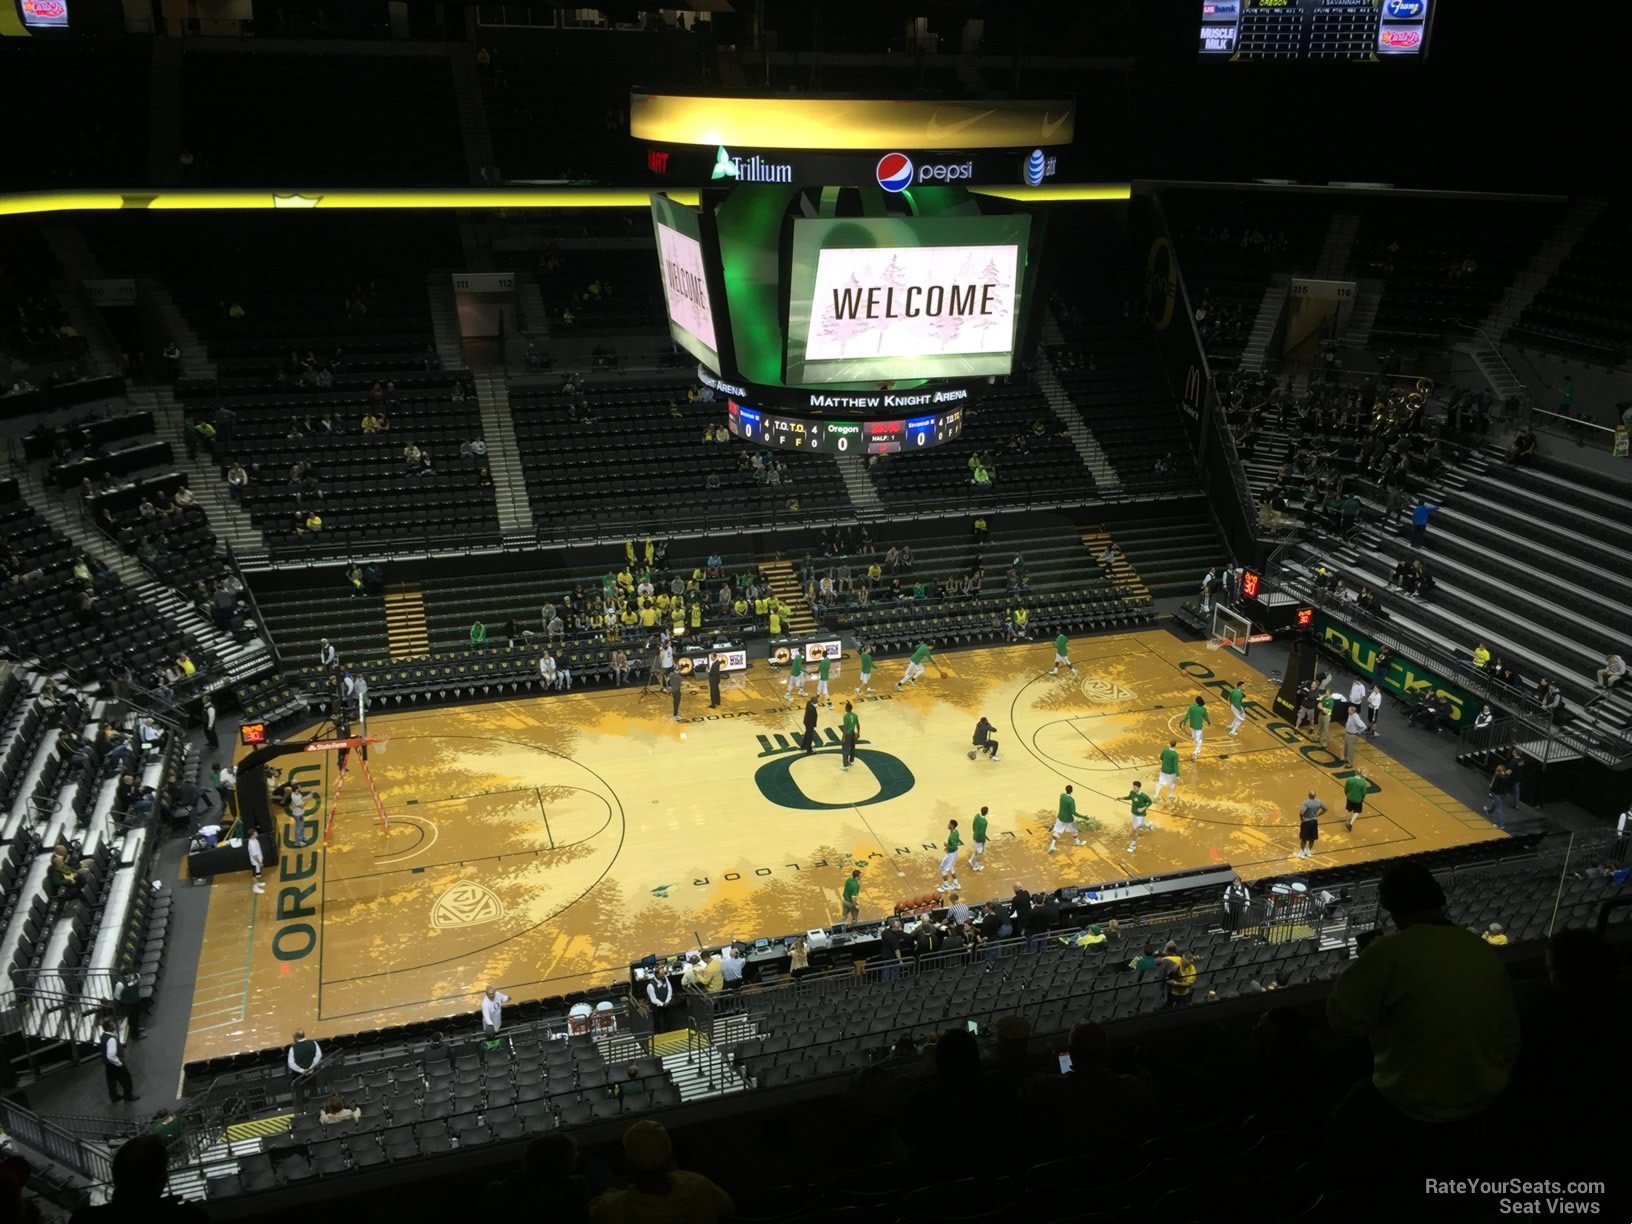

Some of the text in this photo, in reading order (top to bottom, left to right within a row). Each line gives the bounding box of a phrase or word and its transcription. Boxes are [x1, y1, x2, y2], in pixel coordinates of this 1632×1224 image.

[1200, 28, 1234, 39] MUSCLE
[1205, 40, 1227, 49] MILK
[732, 156, 792, 183] Trillium
[918, 161, 972, 183] pepsi
[665, 259, 706, 310] WELCOME
[833, 284, 996, 320] WELCOME
[717, 380, 747, 398] ARENA
[810, 389, 967, 408] MATTHEW KNIGHT ARENA
[764, 419, 769, 428] 4
[811, 425, 817, 434] 4
[827, 424, 859, 434] Oregon
[745, 423, 752, 438] 0
[764, 432, 770, 442] 0
[780, 435, 786, 444] F
[917, 432, 925, 446] 0
[811, 439, 818, 448] 0
[837, 437, 848, 452] 0
[1299, 615, 1309, 624] 30
[248, 731, 260, 740] 30
[692, 859, 828, 886] FLOOR
